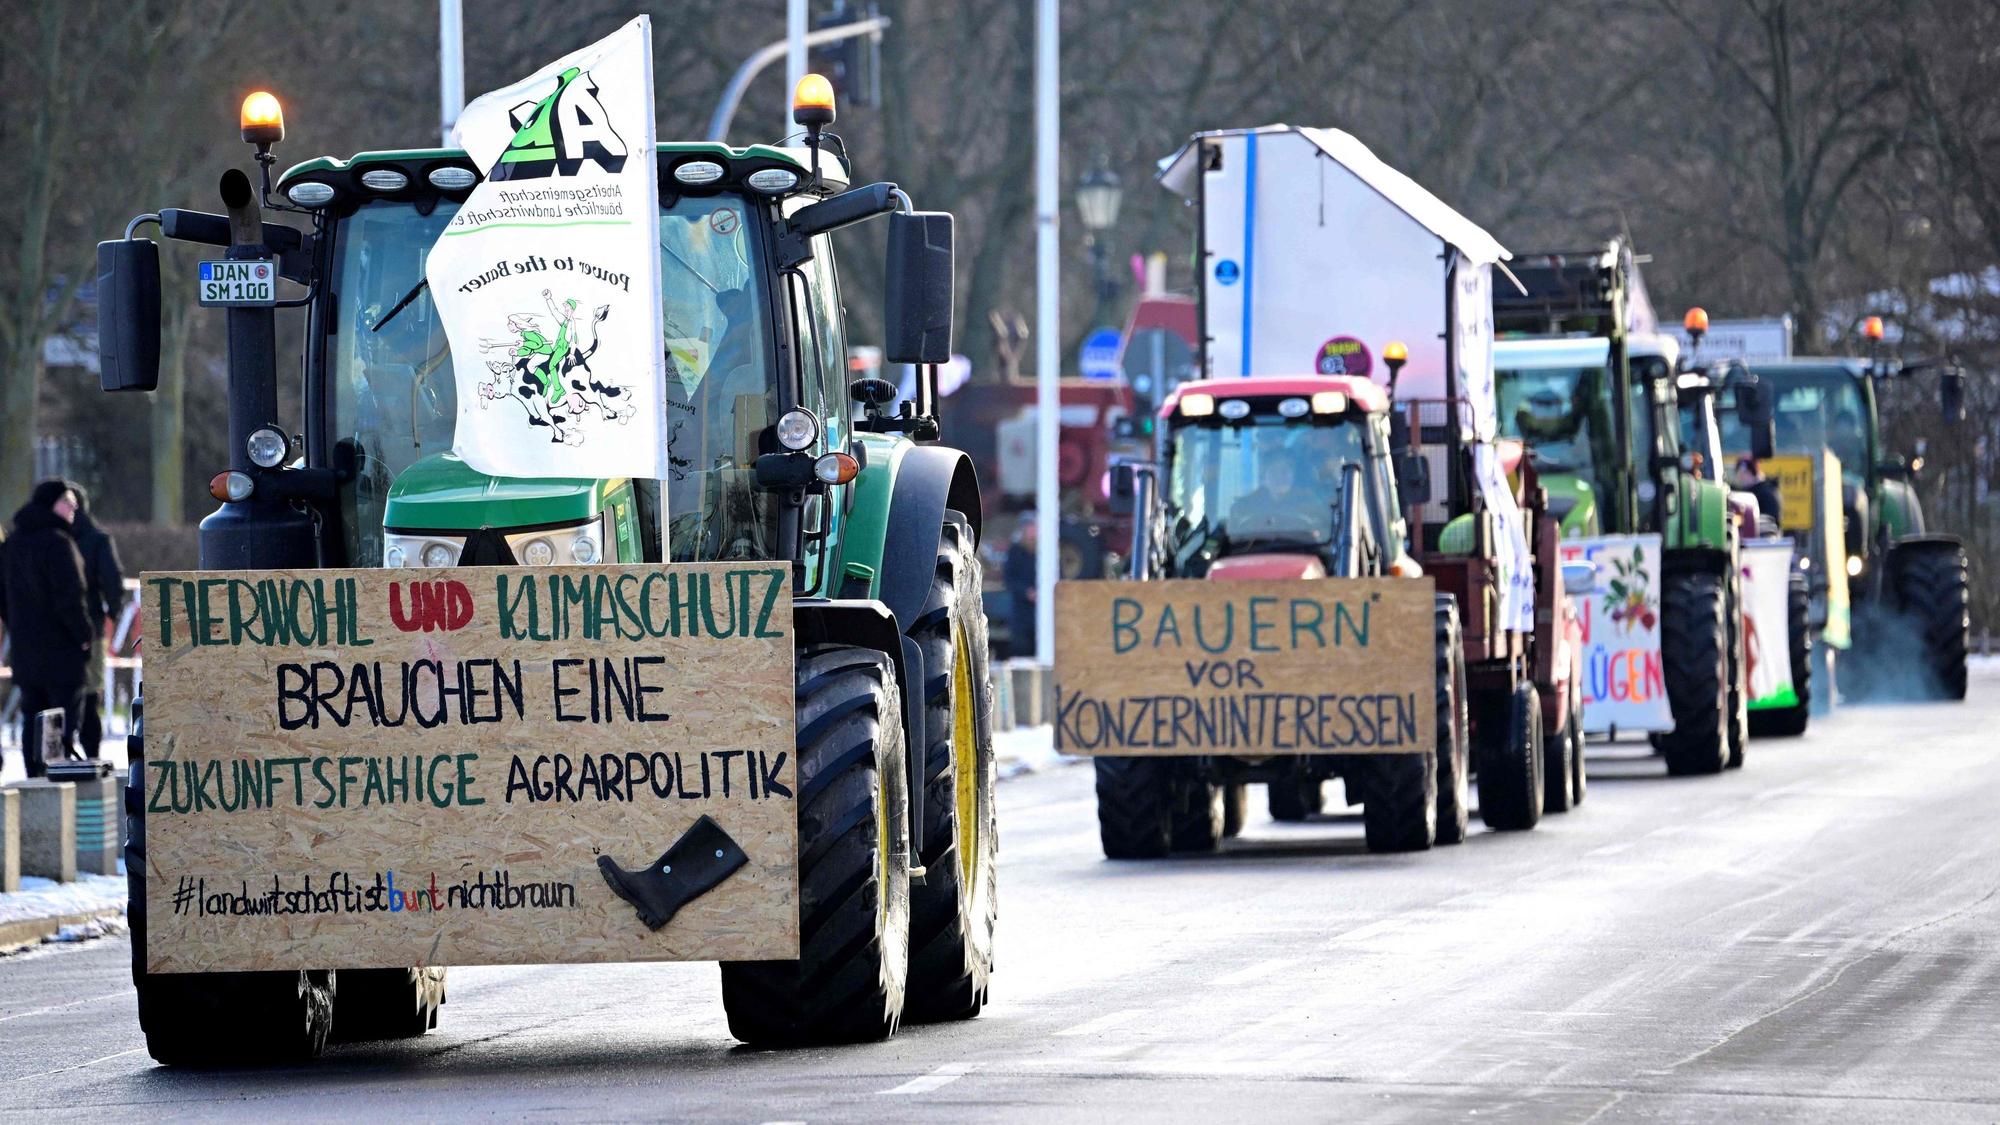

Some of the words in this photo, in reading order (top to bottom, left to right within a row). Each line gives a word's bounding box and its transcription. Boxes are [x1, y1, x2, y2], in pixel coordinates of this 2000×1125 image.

[206, 283, 230, 299] SM
[234, 283, 269, 299] 100
[213, 264, 249, 281] DAN
[148, 577, 374, 647] TIERWOHL
[389, 580, 474, 633] UND
[497, 568, 786, 642] KLIMASCHUTZ
[277, 658, 524, 730] BRAUCHEN
[553, 656, 670, 723] EINE
[1185, 658, 1264, 689] VOR
[1055, 684, 1419, 749] KONZERNINTERESSEN
[148, 754, 486, 814] ZUKUNFTSFÄHIGE
[505, 750, 794, 802] AGRARPOLITIK
